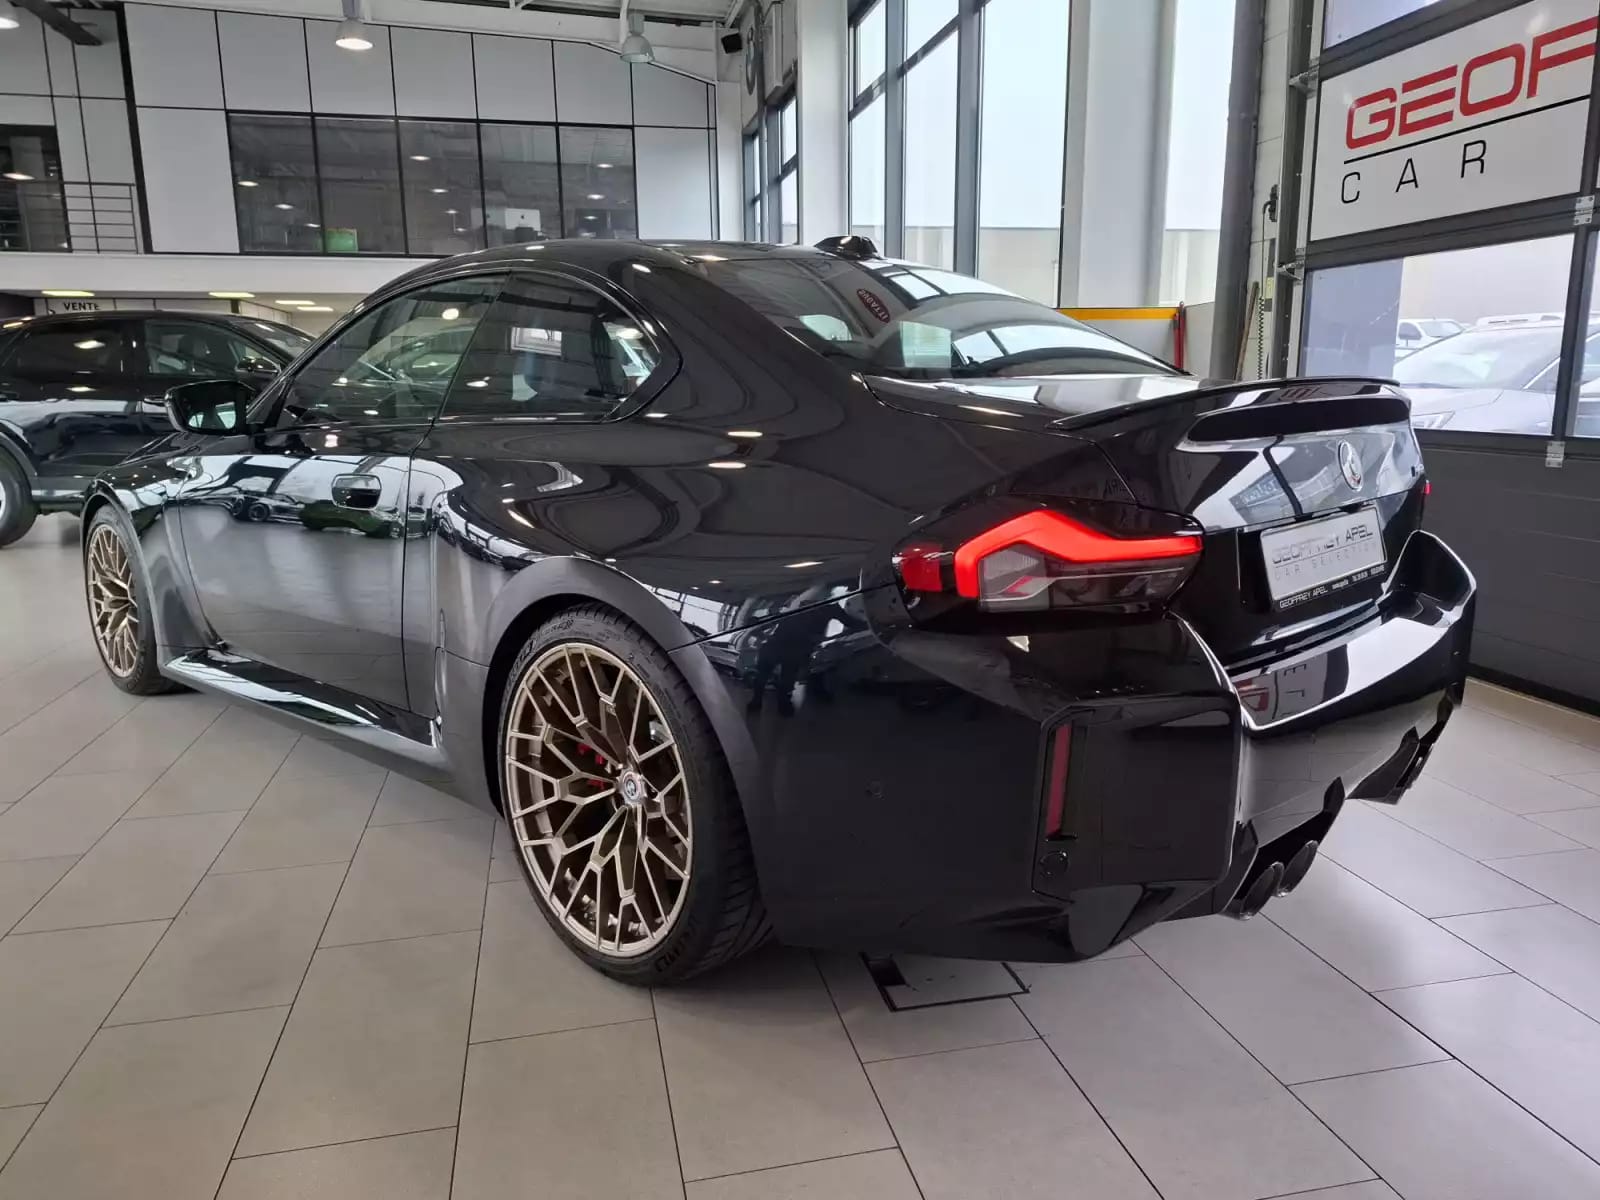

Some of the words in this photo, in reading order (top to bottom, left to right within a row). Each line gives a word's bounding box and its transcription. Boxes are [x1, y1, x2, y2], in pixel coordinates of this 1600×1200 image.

[1345, 16, 1599, 150] GEOF
[1341, 139, 1487, 204] CAR
[63, 302, 100, 311] VENTE
[1345, 524, 1374, 542] APEL
[1312, 585, 1329, 597] APEL
